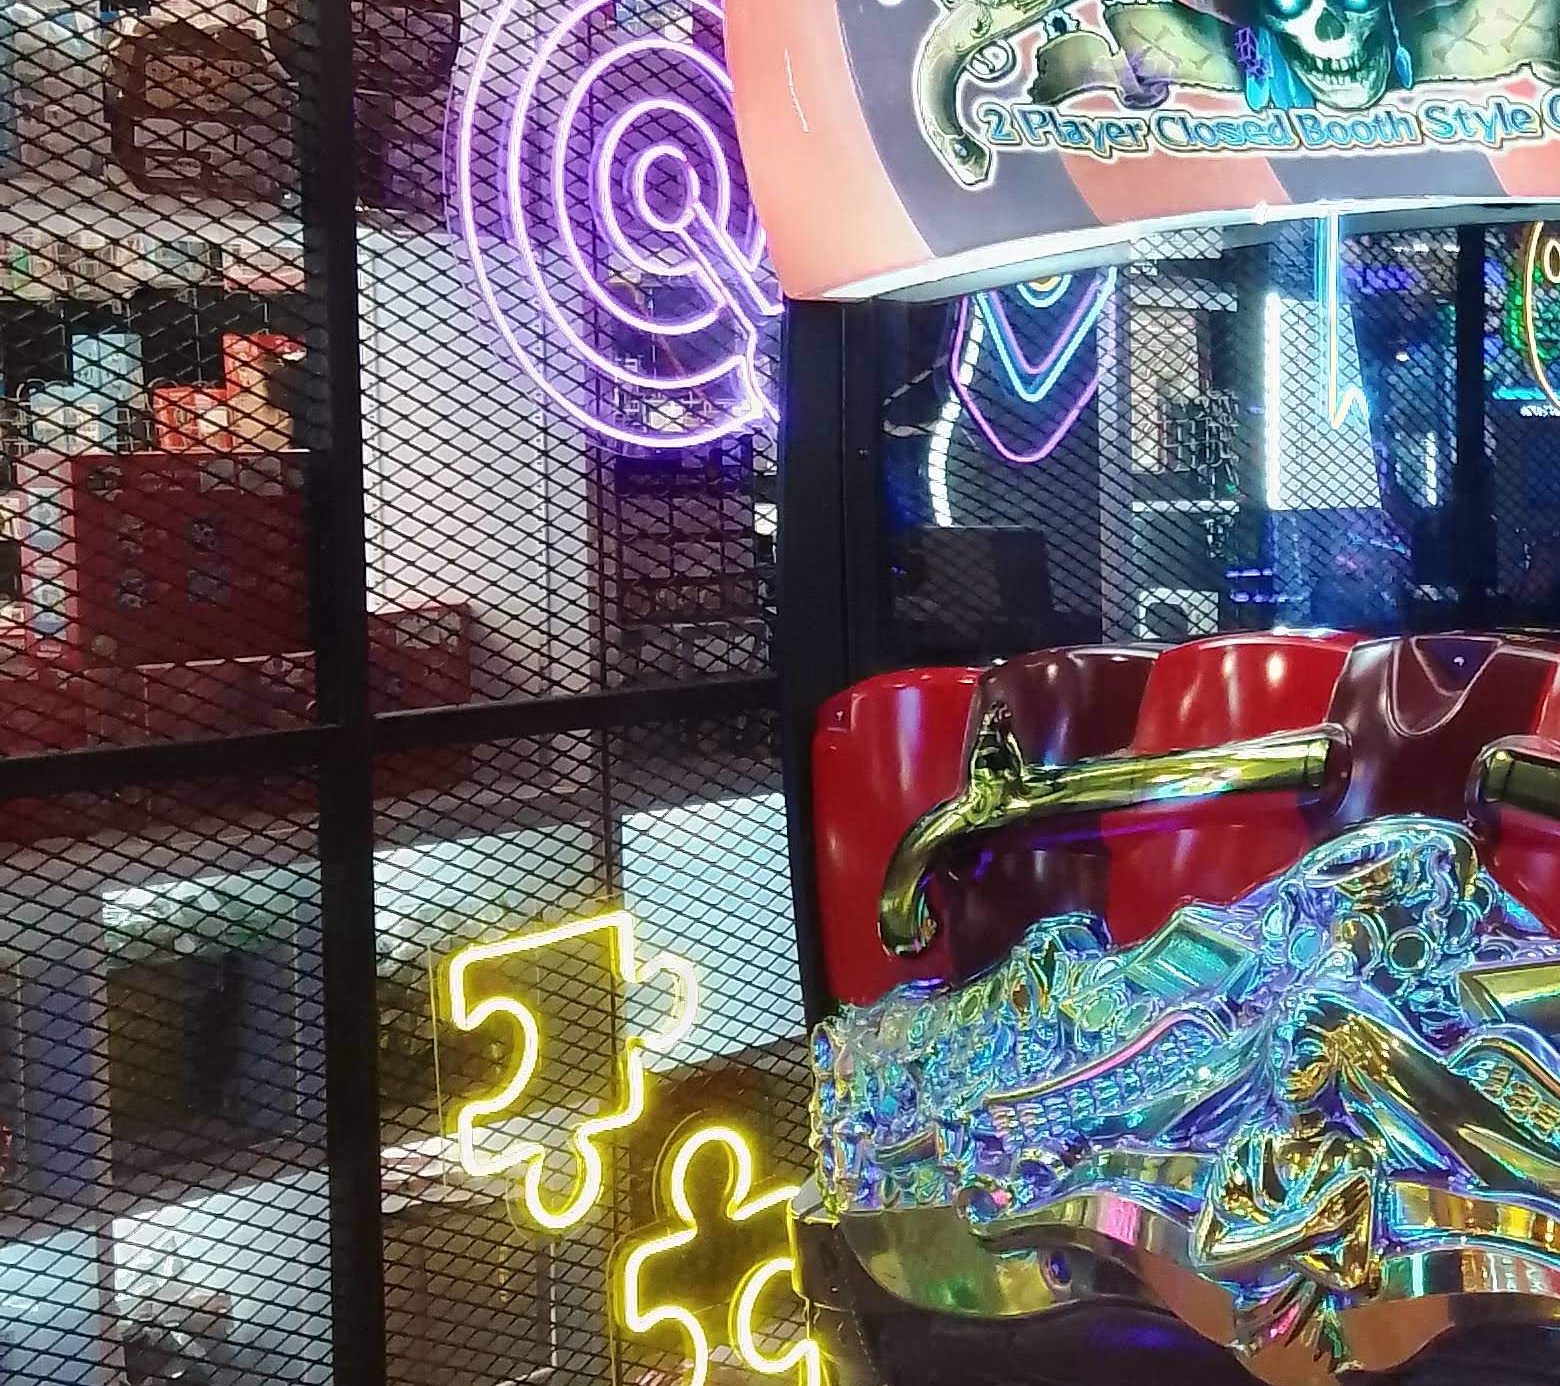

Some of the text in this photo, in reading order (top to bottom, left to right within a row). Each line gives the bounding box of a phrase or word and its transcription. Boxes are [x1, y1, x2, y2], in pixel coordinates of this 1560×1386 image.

[987, 108, 1016, 142] 2
[1023, 109, 1146, 153] Player
[1154, 111, 1293, 147] Closed
[1299, 109, 1419, 145] Booth
[1426, 100, 1536, 145] Style
